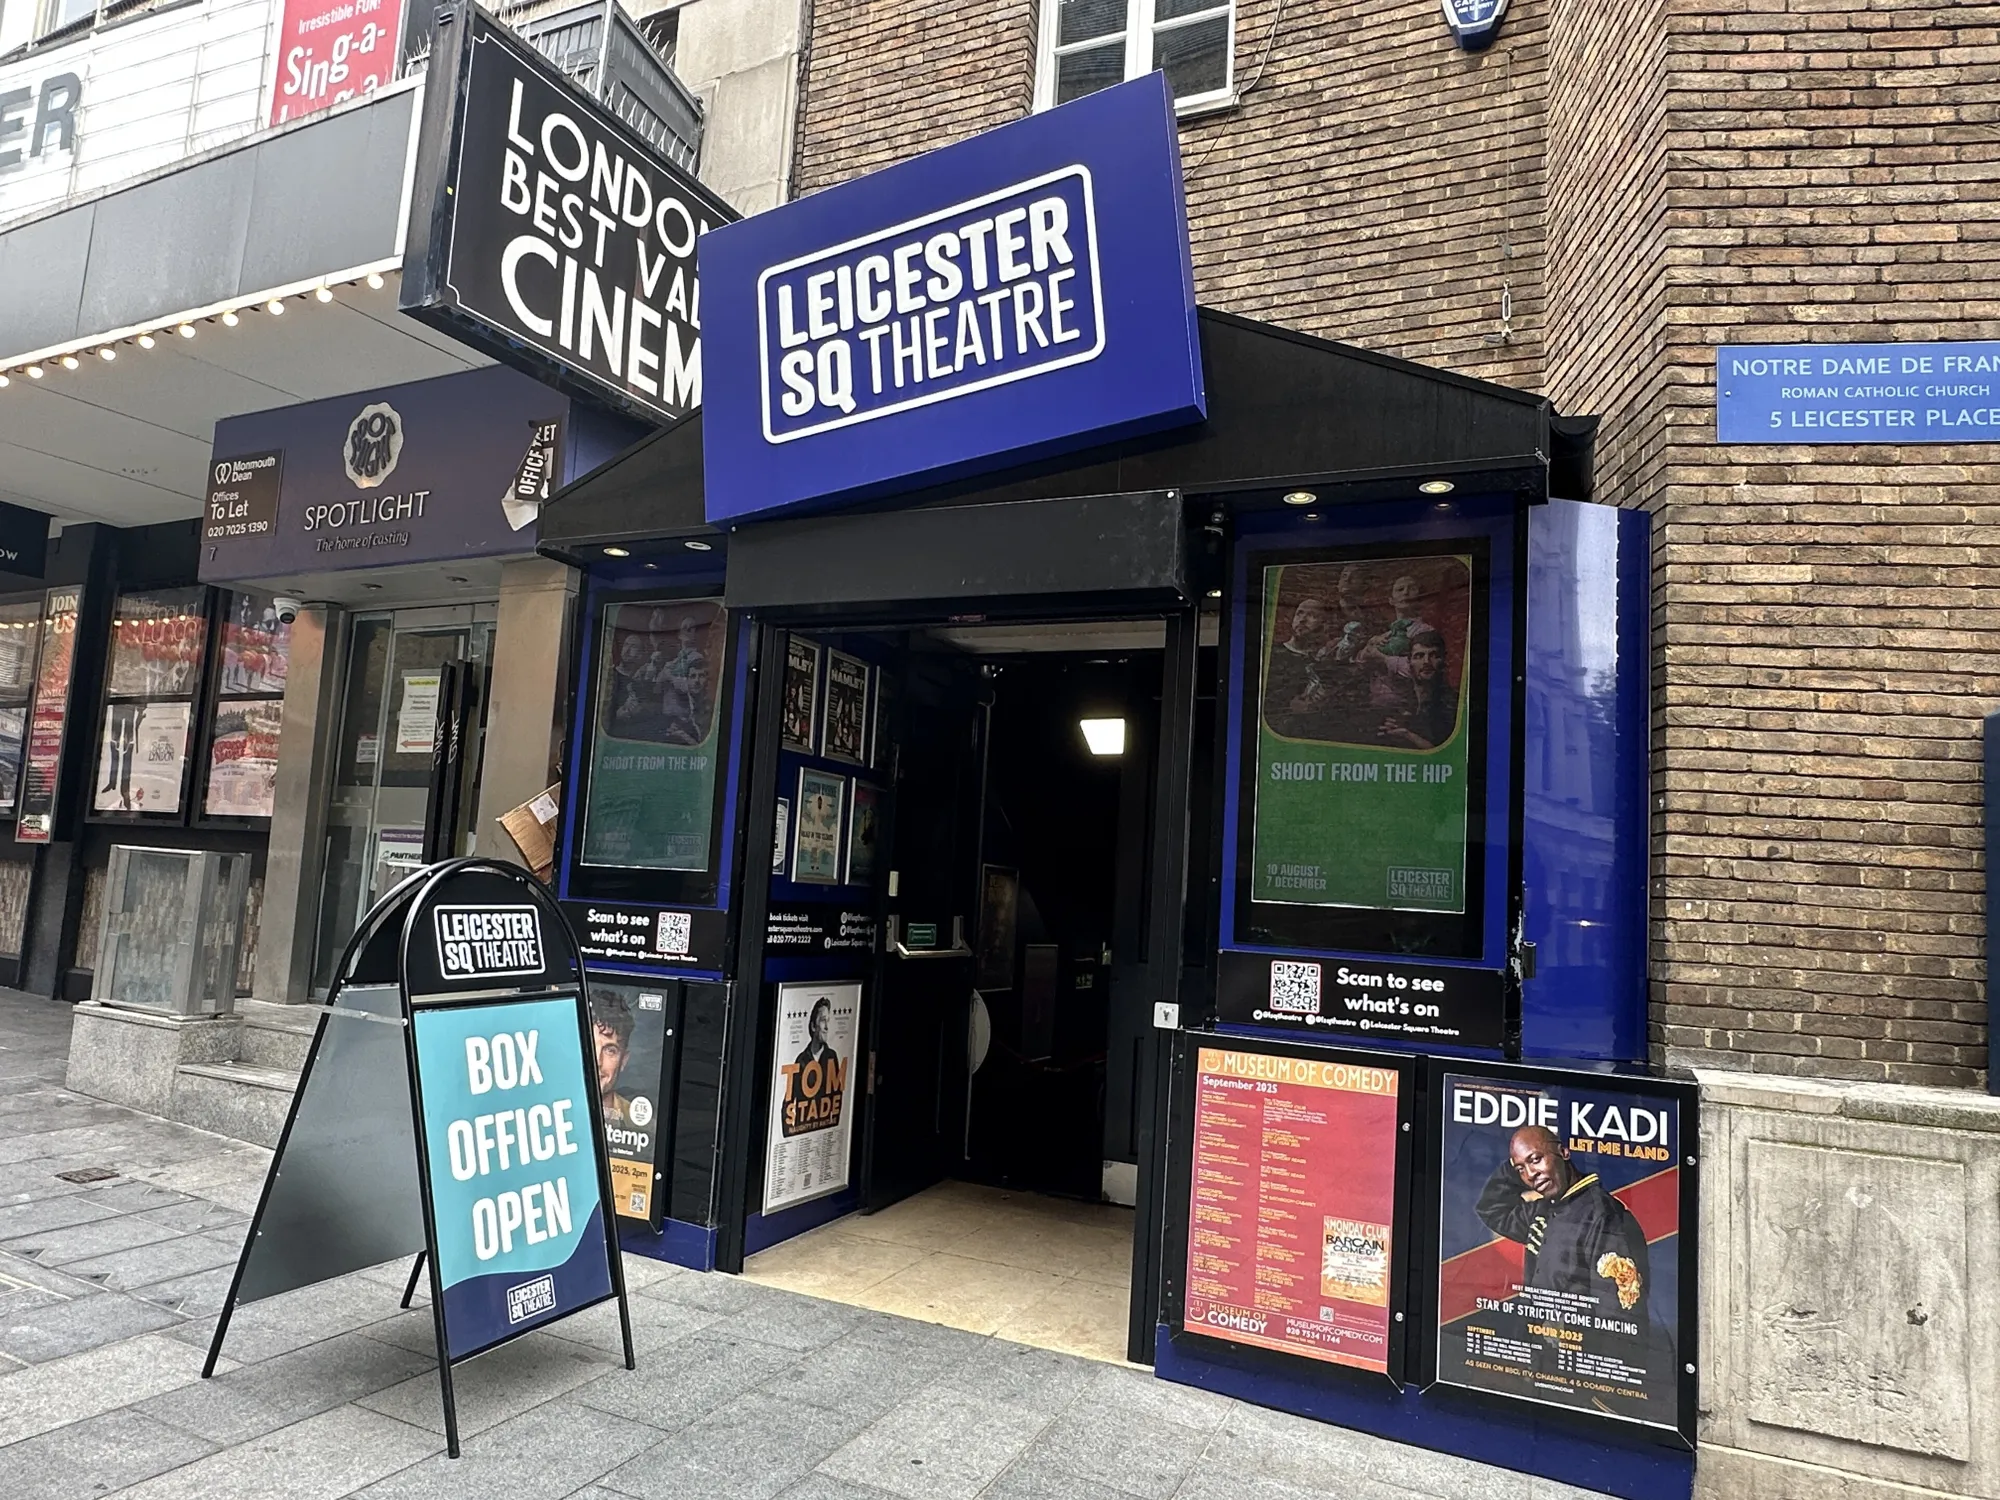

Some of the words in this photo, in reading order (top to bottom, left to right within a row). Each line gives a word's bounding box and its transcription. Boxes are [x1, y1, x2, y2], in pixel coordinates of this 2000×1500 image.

[508, 77, 709, 264] LONDO
[501, 147, 616, 268] BEST
[778, 197, 1074, 349] LEICESTER
[501, 235, 703, 411] CINEM
[780, 338, 857, 417] SQ
[859, 268, 1081, 394] THEATRE
[1732, 359, 1812, 376] NOTRE
[1823, 357, 1891, 375] DAME
[1901, 356, 1934, 374] DE
[1781, 387, 1839, 399] ROMAN
[1844, 385, 1919, 398] CATHOLIC
[1925, 384, 1990, 397] CHURCH
[1770, 411, 1782, 428] 5
[1791, 409, 1916, 427] LEICESTER
[1926, 408, 2000, 426] PLACE
[233, 456, 275, 471] Monmouth
[231, 471, 252, 482] Dean
[212, 491, 239, 502] Offices
[211, 503, 225, 520] To
[228, 499, 249, 518] Let
[304, 490, 430, 531] SPOTLIGHT
[208, 526, 224, 537] 020
[226, 523, 246, 535] 7025
[248, 521, 268, 532] 1390
[316, 538, 333, 551] The
[335, 536, 362, 550] home
[362, 532, 374, 548] of
[372, 531, 409, 546] casting
[209, 547, 217, 562] 7
[49, 594, 79, 615] JOIN
[53, 612, 76, 634] US
[602, 756, 634, 770] SHOOT
[637, 756, 665, 770] FROM
[669, 756, 686, 770] THE
[690, 756, 708, 770] HIP
[1271, 762, 1326, 781] SHOOT
[1331, 763, 1378, 782] FROM
[1384, 763, 1417, 782] THE
[1423, 764, 1452, 783] HIP
[1267, 863, 1277, 875] 10
[1280, 864, 1320, 877] AUGUST
[1391, 870, 1449, 884] LEICESTER
[1267, 876, 1272, 887] 7
[1275, 877, 1326, 890] DECEMBER
[1391, 884, 1406, 896] SQ
[1406, 885, 1449, 899] THEATRE
[441, 913, 535, 941] LEICESTER
[587, 908, 614, 923] Scan
[616, 912, 629, 924] to
[630, 916, 650, 926] see
[590, 928, 628, 944] what's
[630, 935, 645, 945] on
[444, 942, 475, 973] SQ
[471, 940, 539, 968] THEATRE
[1336, 967, 1382, 987] Scan
[1386, 973, 1407, 989] to
[1411, 978, 1445, 992] see
[1344, 993, 1409, 1015] what's
[1414, 1003, 1440, 1017] on
[1370, 1020, 1402, 1031] Leicester
[1402, 1024, 1429, 1035] Square
[1430, 1026, 1460, 1036] Theatre
[465, 1030, 543, 1095] BOX
[1224, 1053, 1290, 1081] MUSEUM
[1294, 1061, 1317, 1083] OF
[1322, 1065, 1394, 1092] COMEDY
[781, 1056, 848, 1101] TOM
[1203, 1075, 1254, 1091] September
[1255, 1081, 1278, 1093] 2025
[785, 1095, 841, 1126] STADE
[1454, 1089, 1558, 1133] EDDIE
[1571, 1102, 1668, 1145] KADI
[447, 1098, 578, 1181] OFFICE
[1569, 1138, 1592, 1152] LET
[1598, 1142, 1621, 1156] ME
[1624, 1146, 1669, 1161] LAND
[632, 1168, 648, 1179] 2pm
[472, 1176, 573, 1261] OPEN
[1329, 1219, 1364, 1237] MONDAY
[1366, 1225, 1388, 1239] CLUB
[1333, 1245, 1376, 1256] COMEDY
[510, 1279, 551, 1305] LEICESTER
[522, 1292, 552, 1314] THEATRE
[1209, 1302, 1251, 1319] MUSEUM
[1253, 1310, 1266, 1321] OF
[1207, 1311, 1268, 1334] COMEDY
[1476, 1297, 1499, 1311] STAR
[1502, 1302, 1514, 1313] OF
[1518, 1305, 1562, 1322] STRICTLY
[1564, 1313, 1591, 1327] COME
[1594, 1318, 1638, 1335] DANCING
[1285, 1326, 1300, 1336] 020
[1302, 1329, 1320, 1340] 7534
[1322, 1332, 1341, 1344] 1744
[1286, 1318, 1383, 1344] MUSEUMOFCOMEDY.COM
[1527, 1323, 1557, 1338] TOUR
[1560, 1329, 1583, 1342] 2025
[1475, 1361, 1491, 1369] SEEN
[1493, 1364, 1504, 1372] ON
[1522, 1370, 1534, 1378] ITV,
[1535, 1372, 1568, 1384] CHANNEL
[1583, 1381, 1615, 1393] COMEDY
[1617, 1388, 1648, 1400] CENTRAL
